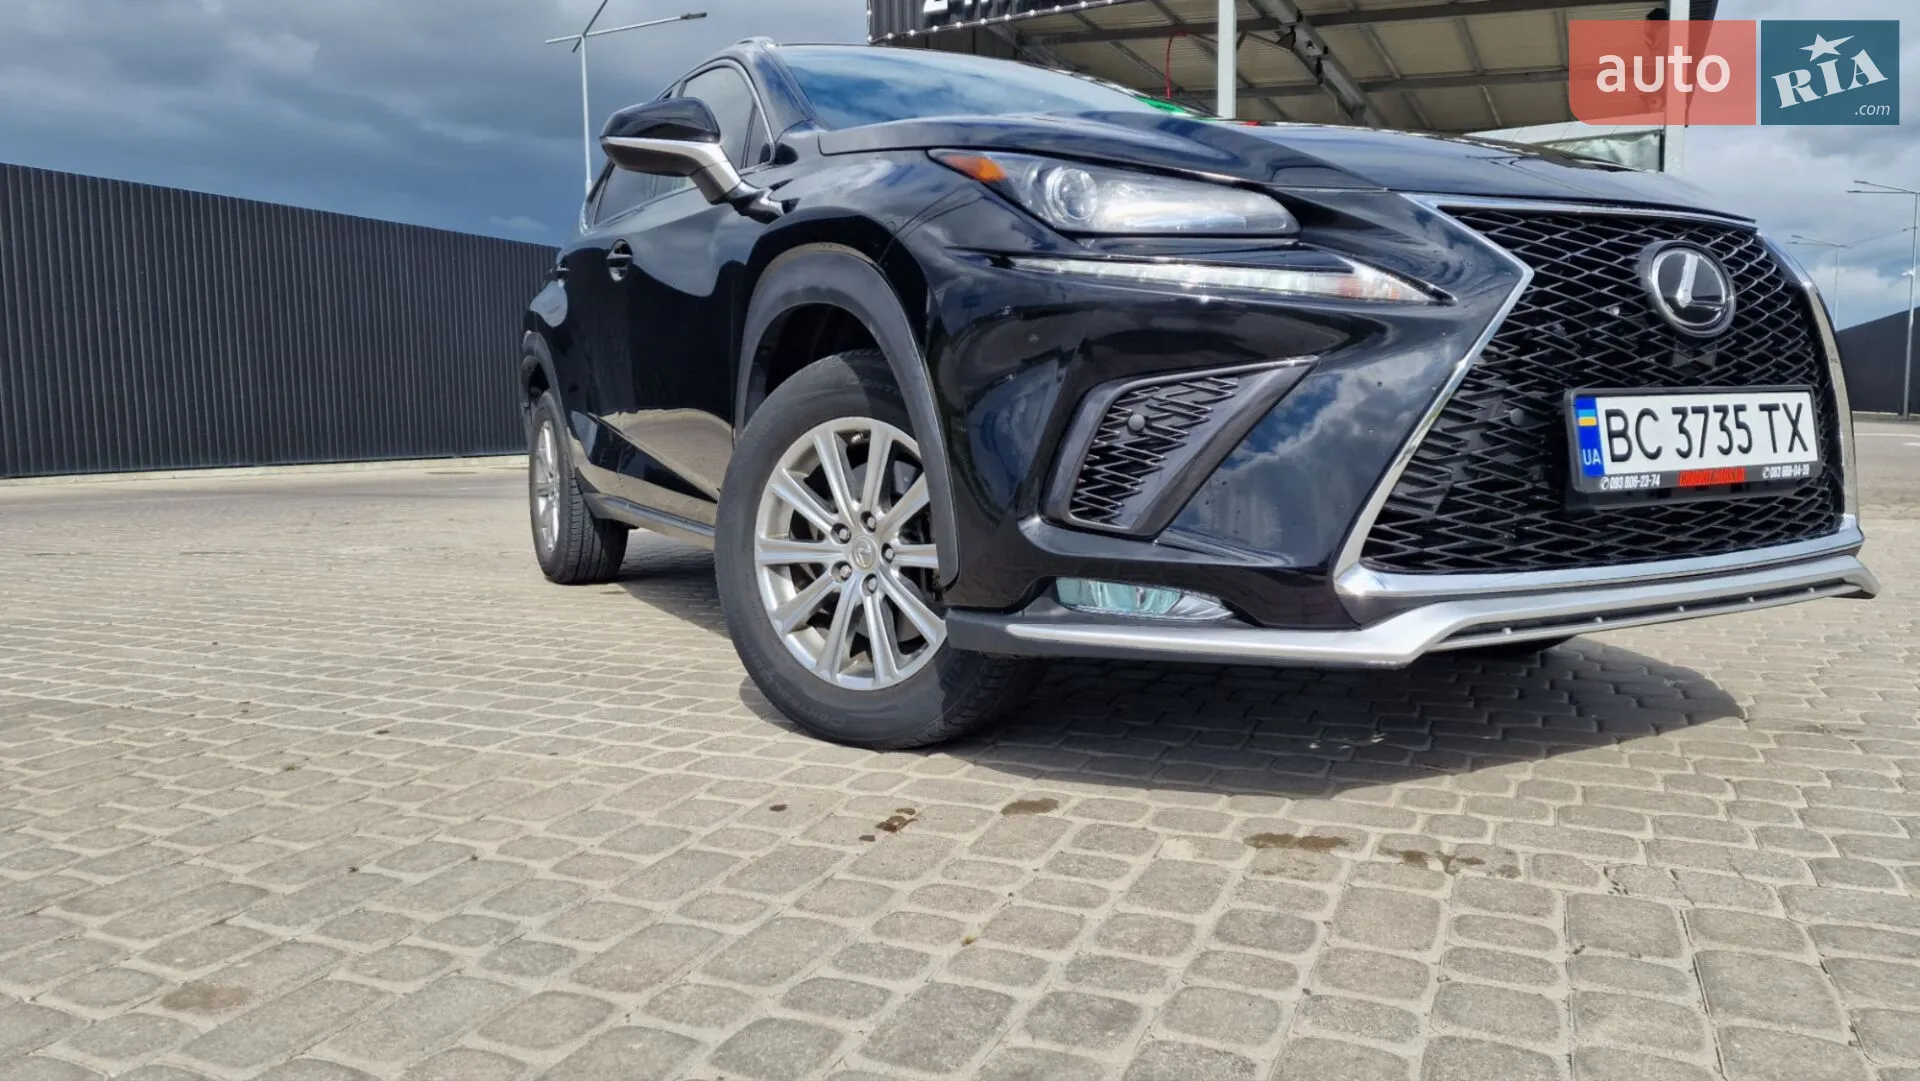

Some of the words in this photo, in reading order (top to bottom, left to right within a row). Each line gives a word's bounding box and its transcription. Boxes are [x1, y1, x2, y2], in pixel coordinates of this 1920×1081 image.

[1605, 407, 1663, 462] BC
[1671, 403, 1752, 459] 3735
[1758, 402, 1809, 454] TX
[1583, 449, 1601, 465] UA
